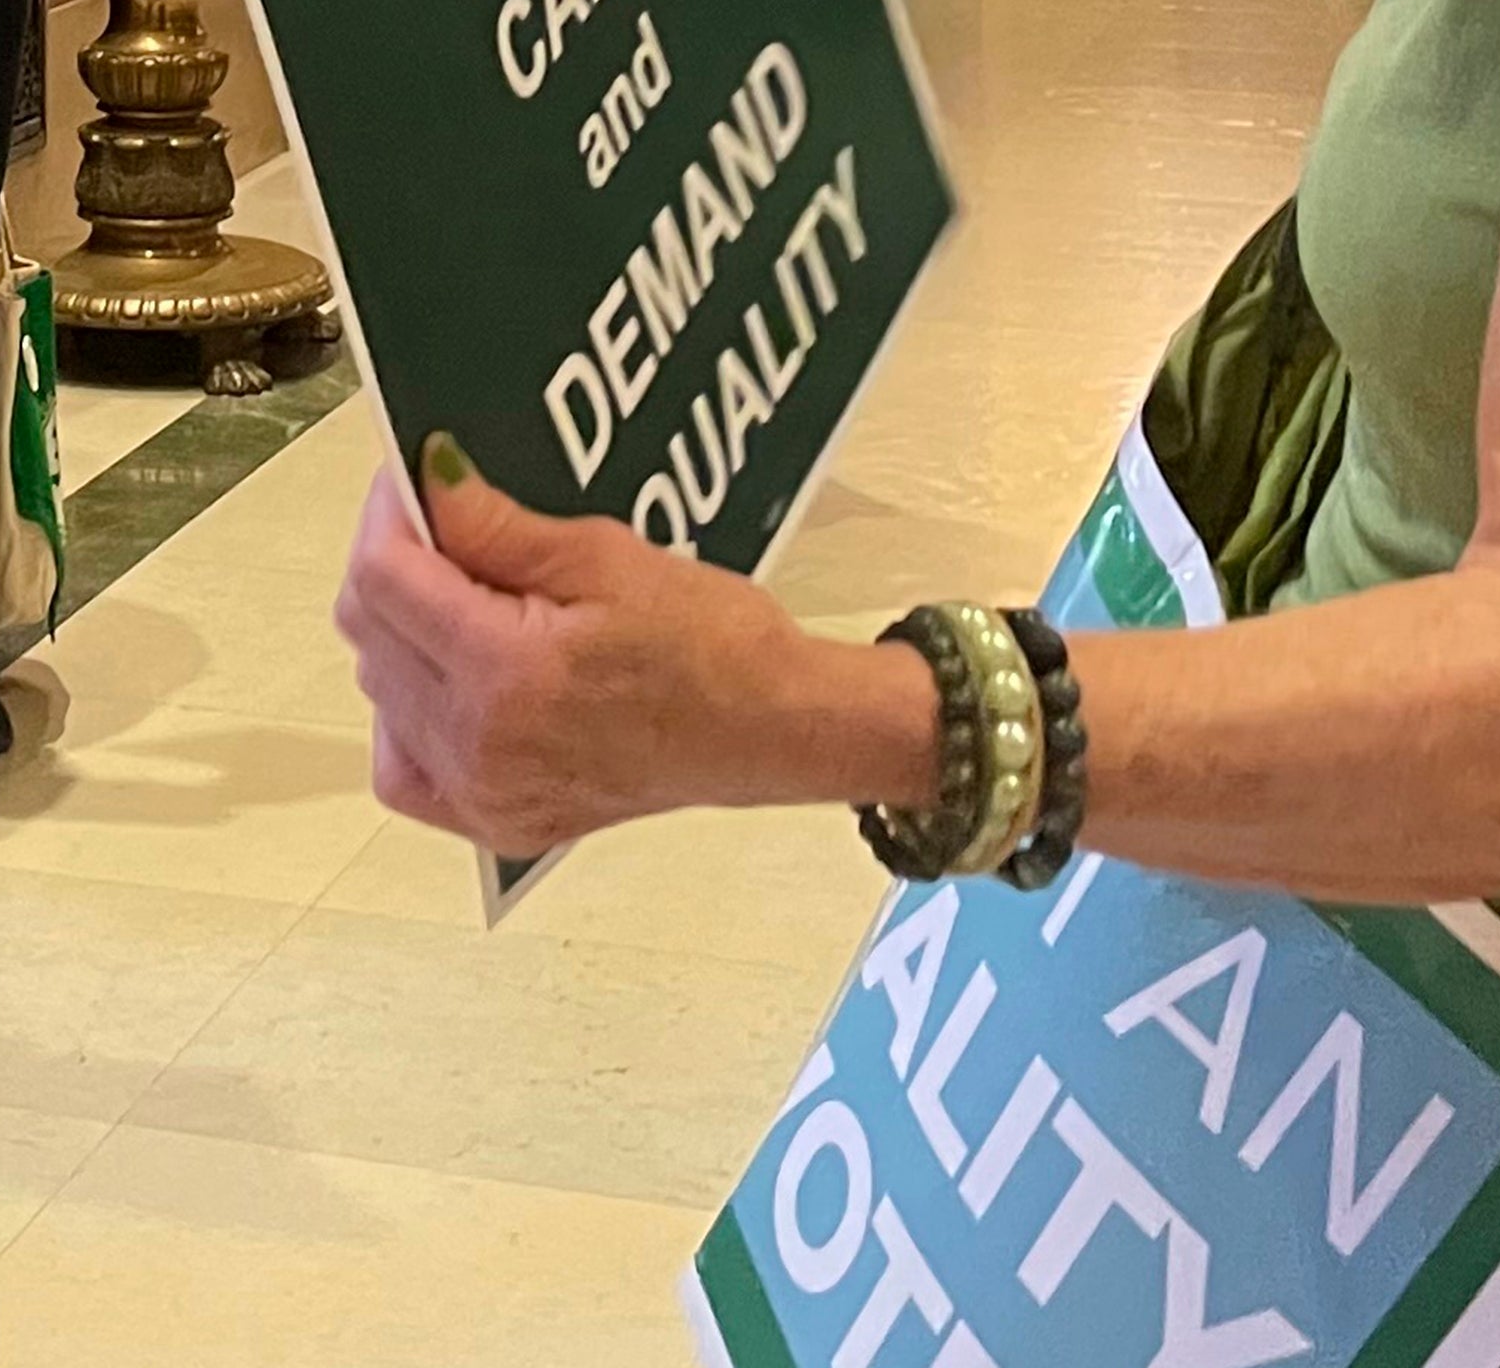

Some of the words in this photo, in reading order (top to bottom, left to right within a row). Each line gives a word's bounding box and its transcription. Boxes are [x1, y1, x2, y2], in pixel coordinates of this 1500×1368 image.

[543, 40, 809, 492] DEMAND
[578, 10, 673, 190] and
[632, 144, 868, 559] QUALITY
[859, 881, 1314, 1368] ALITY
[1101, 925, 1457, 1257] AN
